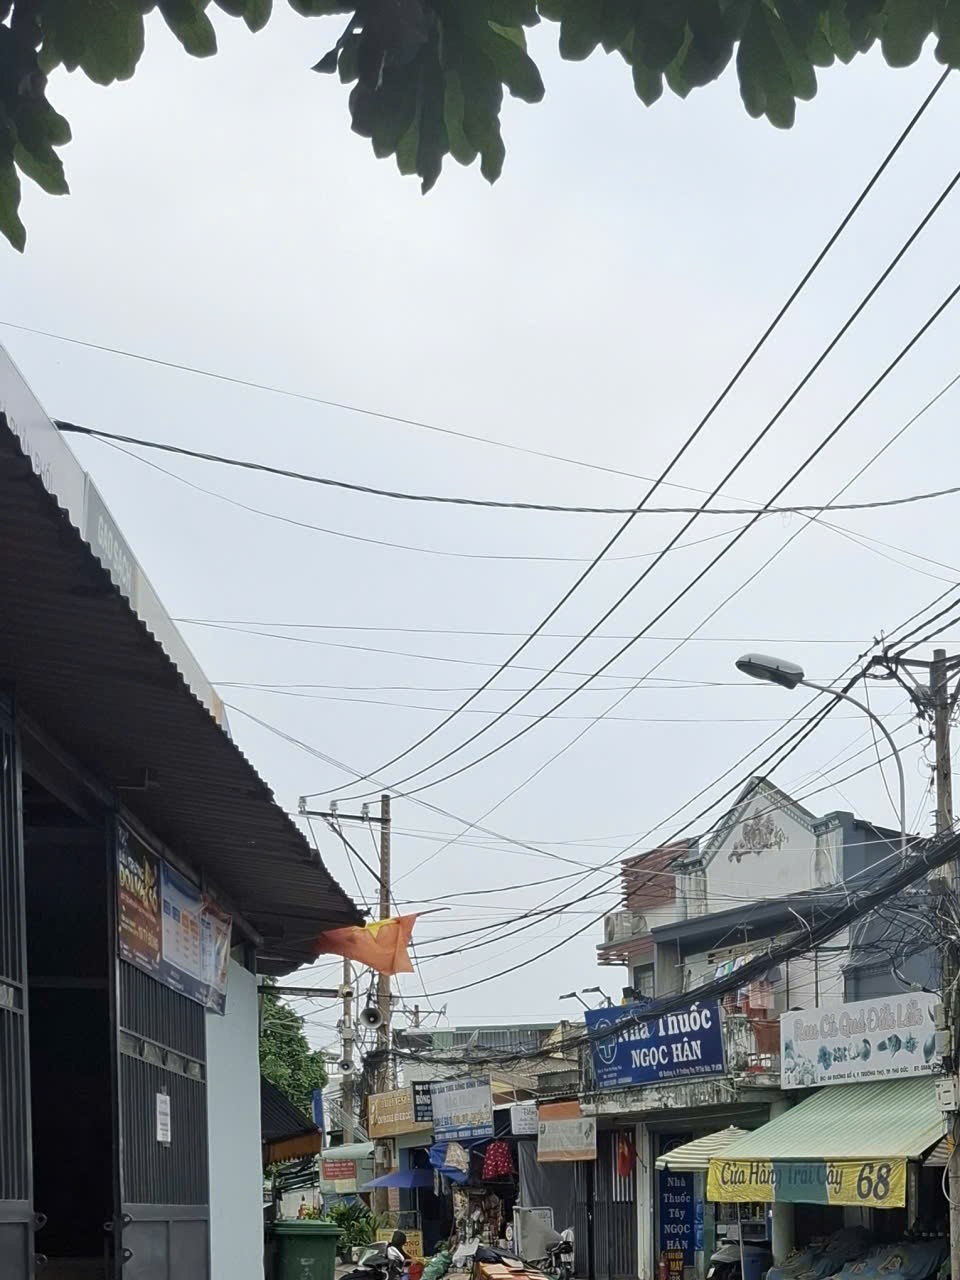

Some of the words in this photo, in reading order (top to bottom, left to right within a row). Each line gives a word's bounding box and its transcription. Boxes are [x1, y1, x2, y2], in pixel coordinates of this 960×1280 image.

[658, 1001, 711, 1036] Thuốc
[631, 1045, 668, 1070] NGỌC
[671, 1037, 702, 1063] HÂN
[667, 1177, 686, 1187] Nhà
[721, 1162, 746, 1186] Cửa
[749, 1162, 782, 1188] Hàng
[816, 1164, 843, 1194] Cây
[856, 1163, 891, 1200] 68
[663, 1191, 691, 1203] Thuốc
[668, 1208, 686, 1220] Tây
[664, 1224, 691, 1235] NGỌC
[666, 1238, 688, 1250] HÂN
